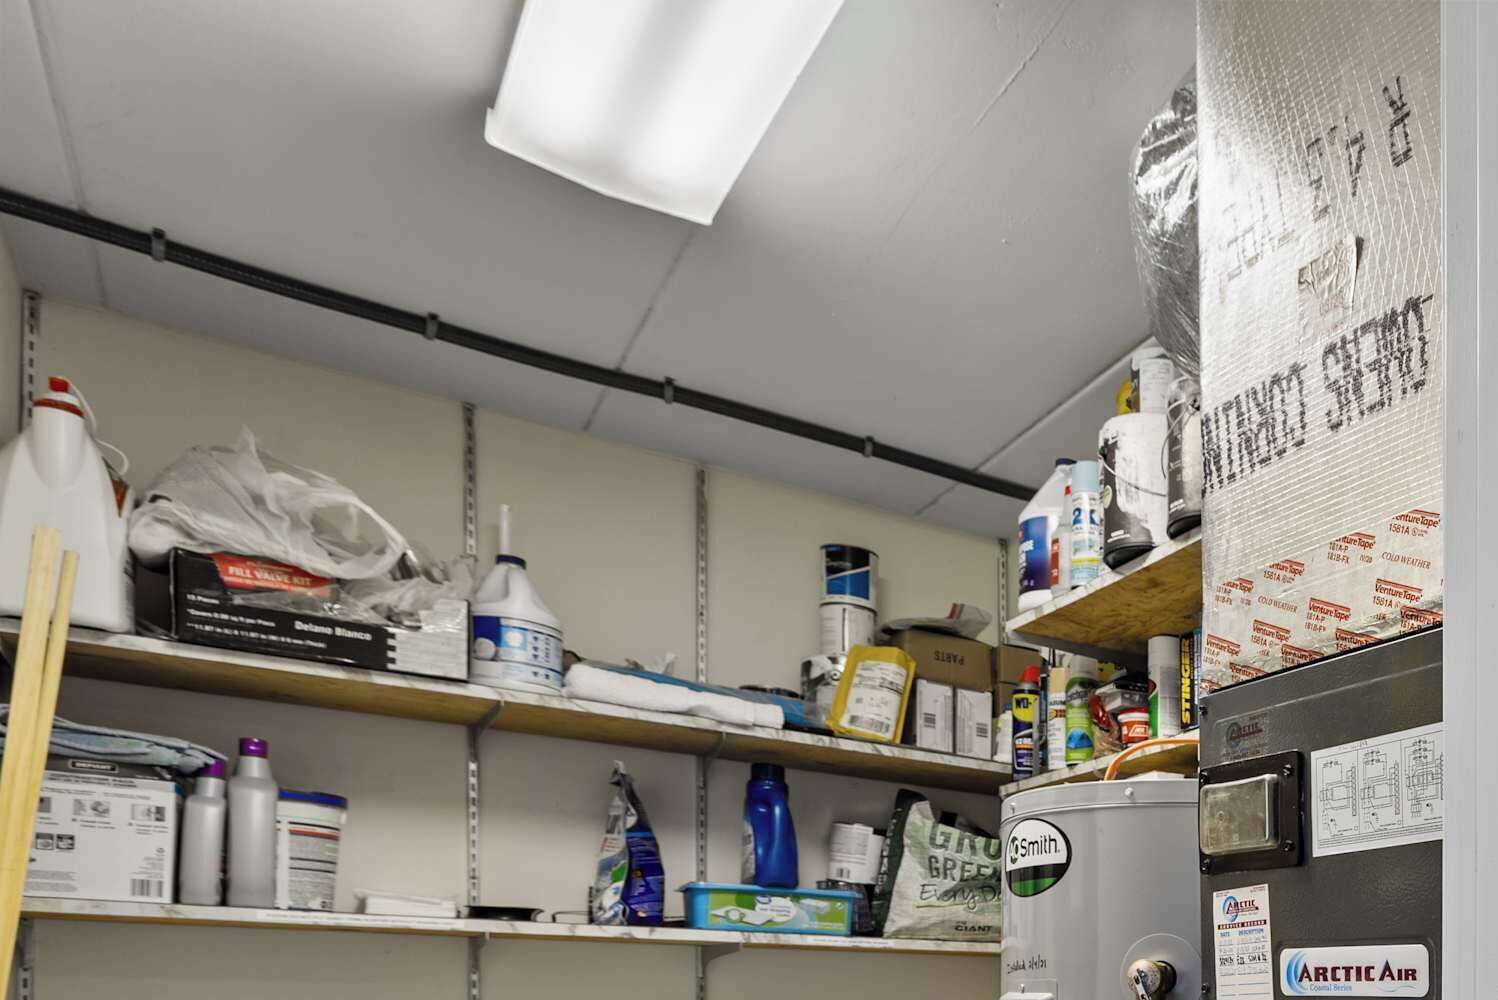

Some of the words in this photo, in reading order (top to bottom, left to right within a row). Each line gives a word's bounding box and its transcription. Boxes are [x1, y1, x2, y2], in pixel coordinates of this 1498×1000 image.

[1322, 294, 1433, 433] OWENS
[1381, 551, 1400, 562] COLD
[1400, 555, 1432, 570] WEATHER
[227, 565, 252, 579] FILL
[255, 568, 290, 584] VALVE
[1375, 583, 1421, 604] VentureTape
[1257, 595, 1273, 606] COLD
[1273, 599, 1298, 614] WEATHER
[1309, 601, 1350, 622] VentureTape
[294, 620, 333, 635] Delano
[334, 627, 373, 641] Blanco
[1253, 622, 1291, 642] VentureTape
[934, 650, 965, 666] PARTS
[1206, 638, 1240, 657] VentureTape
[1020, 834, 1058, 858] Smith
[919, 883, 980, 911] Every
[1298, 960, 1376, 983] ARCTIC
[1378, 958, 1417, 982] AIR
